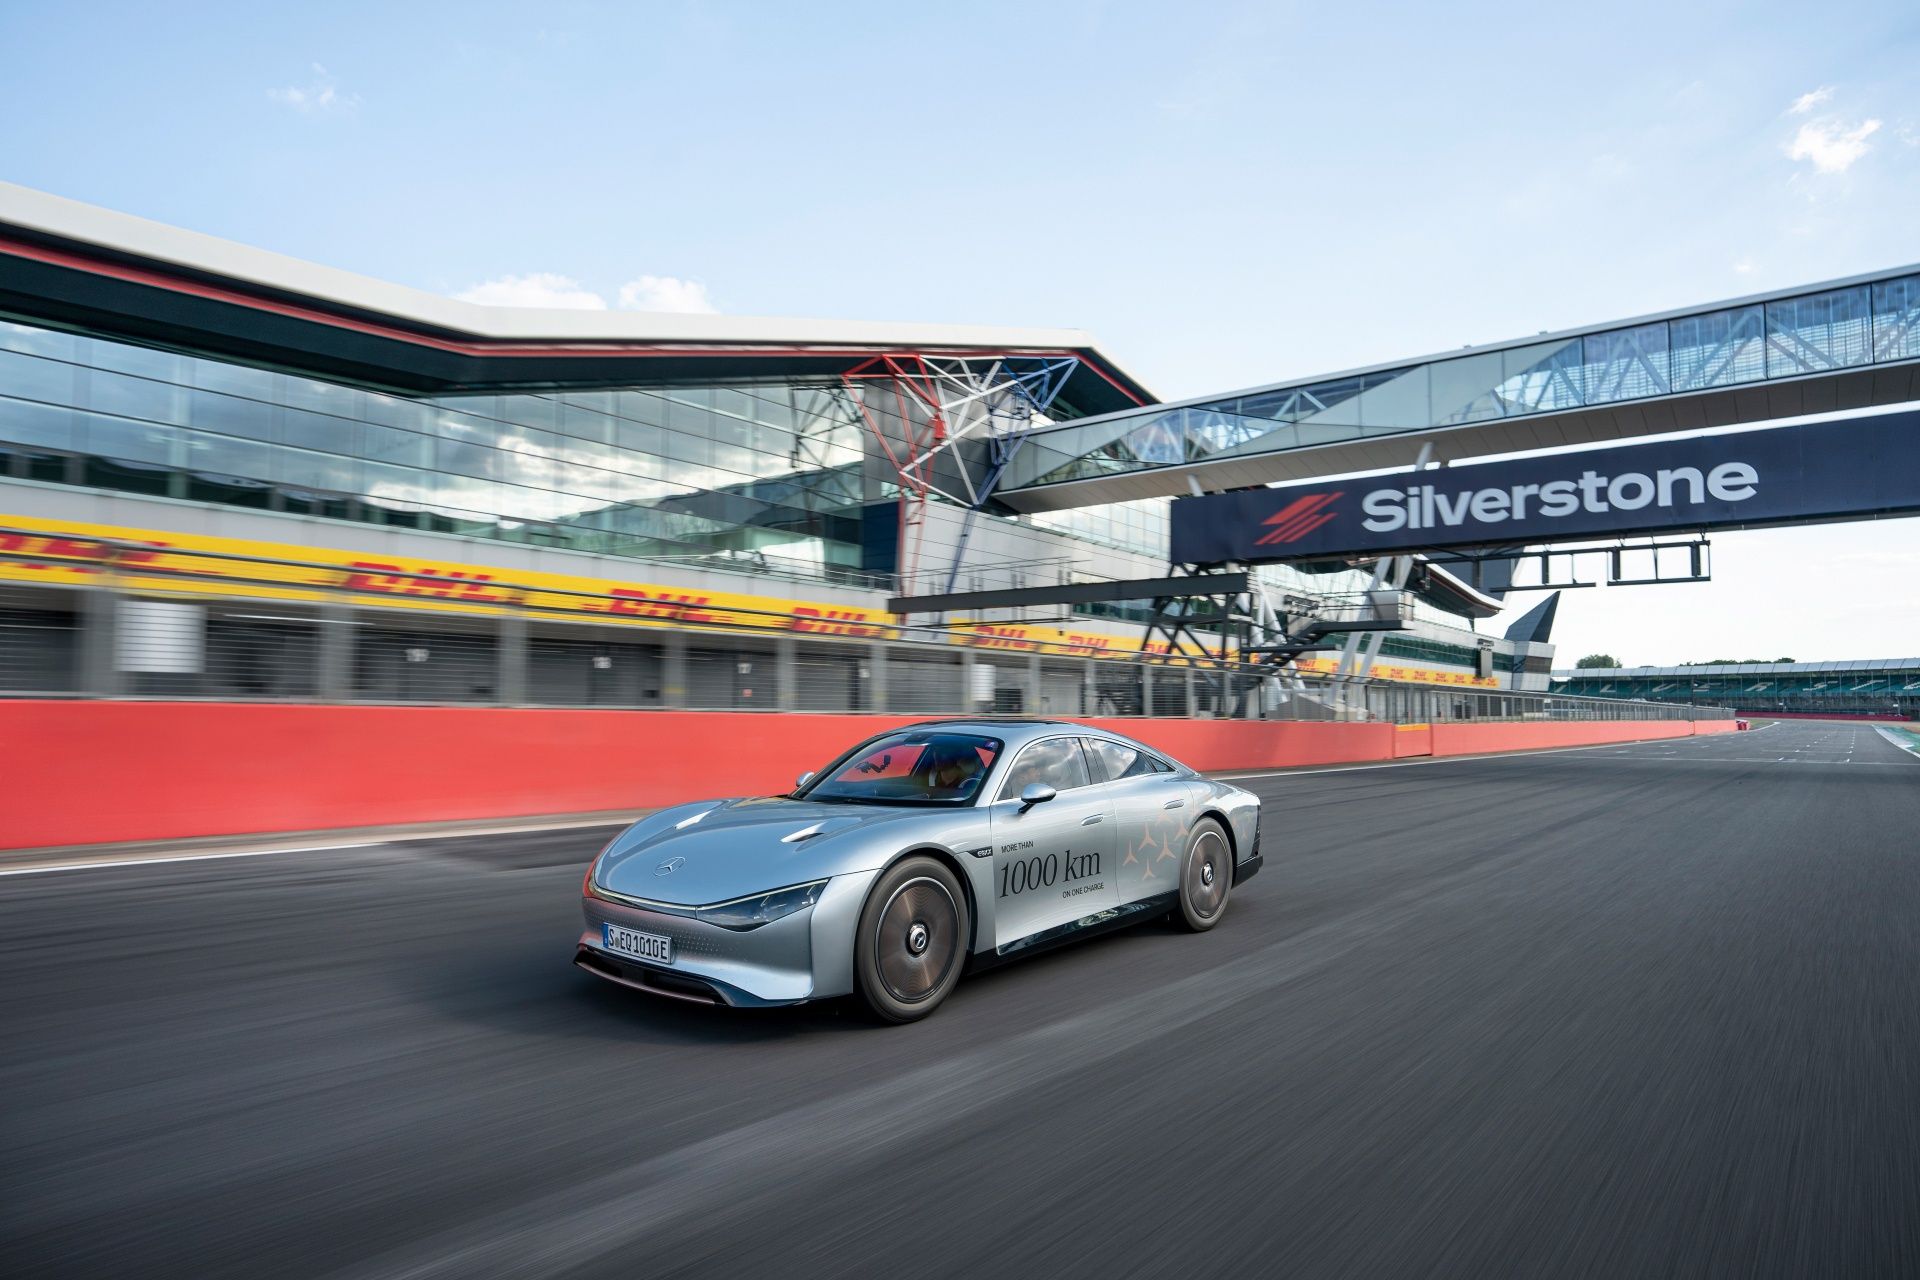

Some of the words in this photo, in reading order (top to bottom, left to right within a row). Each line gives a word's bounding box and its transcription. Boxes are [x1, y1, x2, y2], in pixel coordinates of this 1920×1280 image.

[1361, 462, 1759, 533] Silverstone
[609, 588, 712, 622] DHL
[789, 607, 868, 638] DHL
[1001, 844, 1018, 853] MORE
[1018, 841, 1034, 850] THAN
[1000, 853, 1058, 898] 1000
[1064, 850, 1101, 882] km
[1071, 887, 1083, 896] ONE
[1083, 882, 1104, 893] CHARGE
